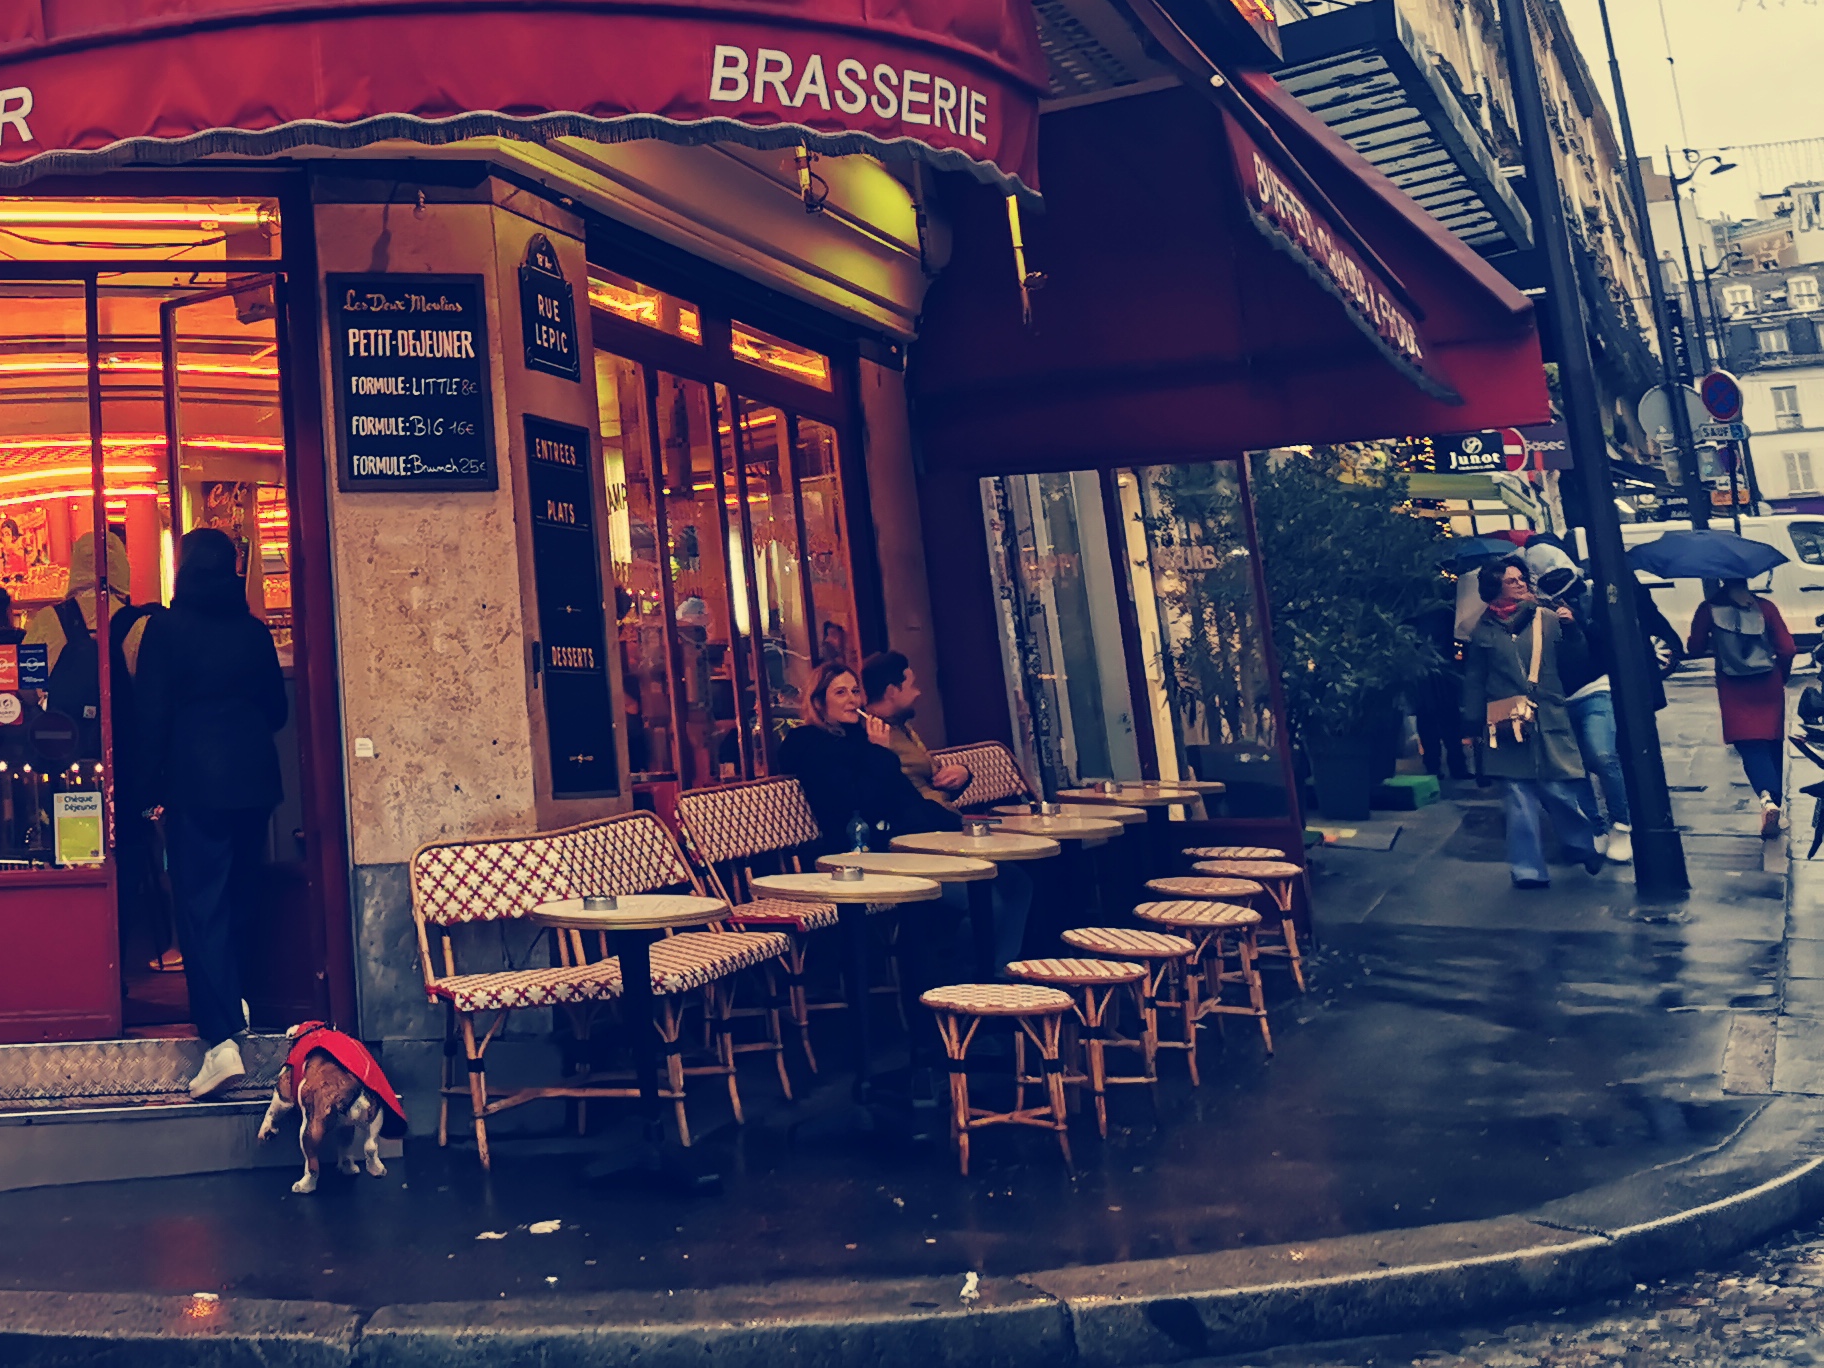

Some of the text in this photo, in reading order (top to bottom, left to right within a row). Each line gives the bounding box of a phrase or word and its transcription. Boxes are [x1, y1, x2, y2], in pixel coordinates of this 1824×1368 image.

[707, 45, 989, 146] BRASSERIE
[537, 293, 561, 323] RUE
[535, 322, 569, 354] LEPIC
[409, 415, 444, 436] BIG
[408, 454, 460, 474] Brunch
[459, 457, 487, 474] 25€
[1449, 451, 1501, 470] Junot
[547, 498, 575, 525] PLATS
[551, 645, 595, 669] DESSERTS
